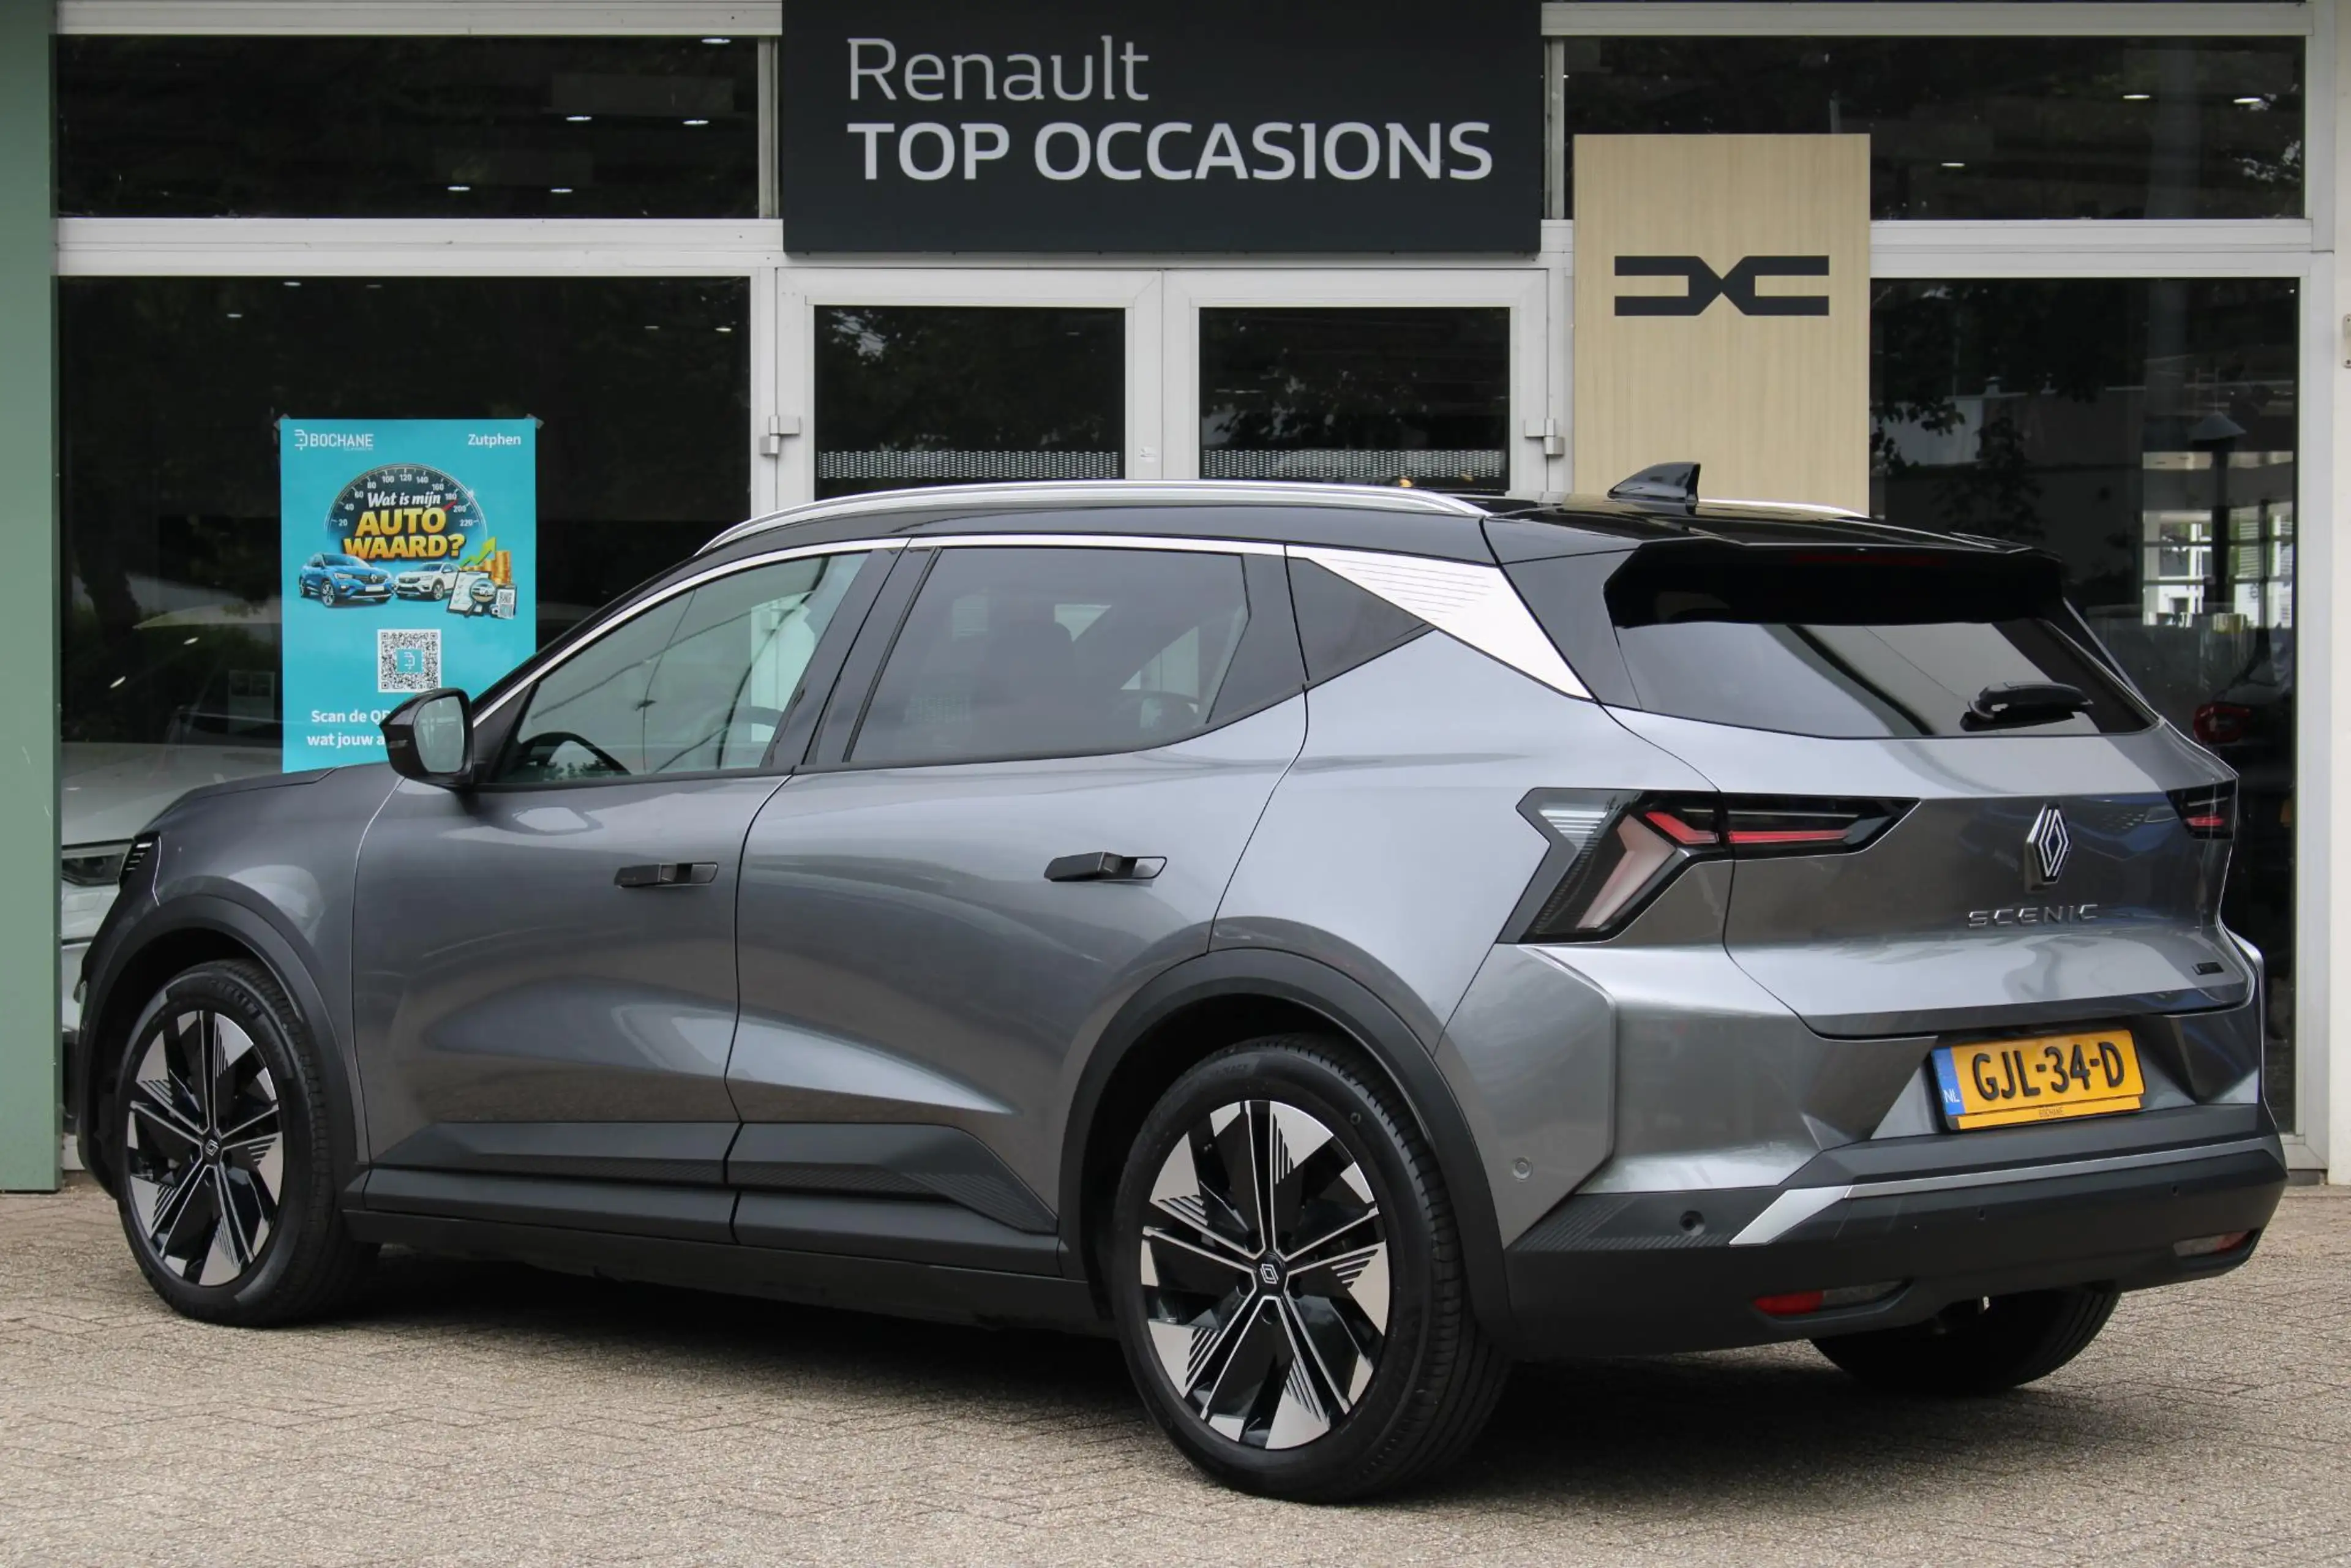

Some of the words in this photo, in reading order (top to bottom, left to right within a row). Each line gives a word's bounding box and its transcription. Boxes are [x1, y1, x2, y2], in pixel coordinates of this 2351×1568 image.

[847, 36, 1150, 102] Renault
[847, 122, 1011, 182] TOP
[1033, 122, 1494, 182] OCCASIONS
[310, 433, 374, 448] BOCHANE
[468, 432, 522, 449] Zutphen
[367, 491, 397, 508] Wat
[399, 492, 410, 505] is
[411, 492, 441, 508] mijn
[355, 508, 446, 537] AUTO
[344, 533, 465, 559] WAARD?
[312, 710, 345, 722] Scan
[349, 709, 367, 722] de
[307, 732, 335, 746] wat
[336, 732, 373, 748] jouw
[1968, 904, 2098, 929] SCENIC
[1972, 1041, 2125, 1101] GJL-34-D
[1943, 1089, 1961, 1103] NL
